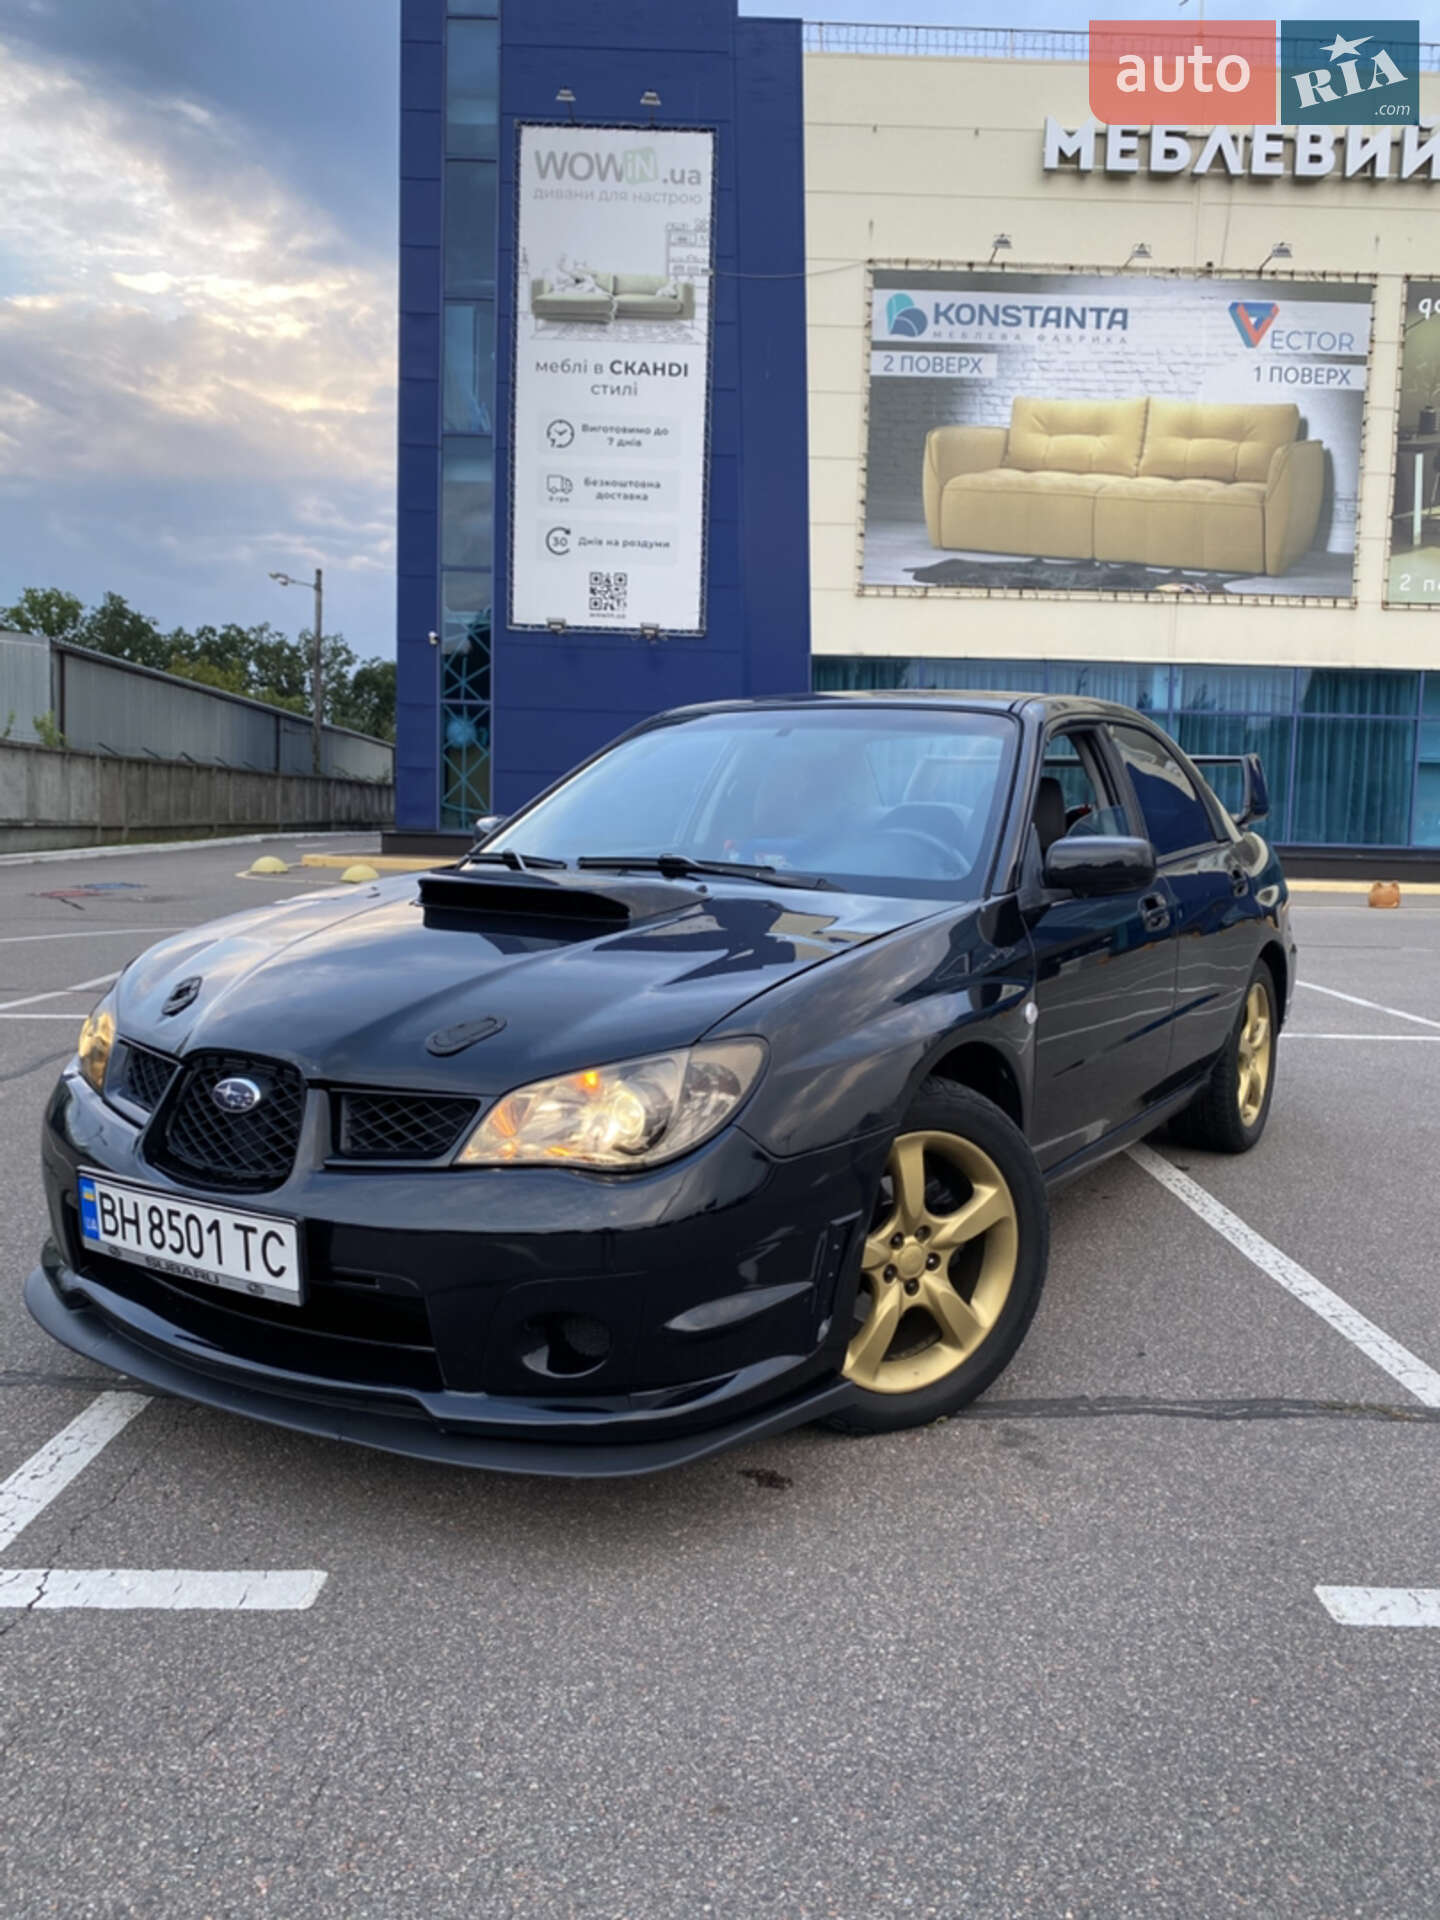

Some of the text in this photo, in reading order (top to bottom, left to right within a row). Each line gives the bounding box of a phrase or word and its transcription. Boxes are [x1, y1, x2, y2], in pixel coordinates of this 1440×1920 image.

[934, 302, 1129, 331] KONSTANTA
[933, 330, 1128, 345] МЕБЛЕВА ФАБРИКА
[535, 359, 588, 375] меблі
[594, 362, 604, 375] в
[883, 355, 983, 374] 2 ПОВЕРХ
[1253, 366, 1351, 385] 1 ПОВЕРХ
[590, 382, 639, 397] стилі
[552, 537, 568, 547] 30
[98, 1190, 287, 1278] BH 8501 TC
